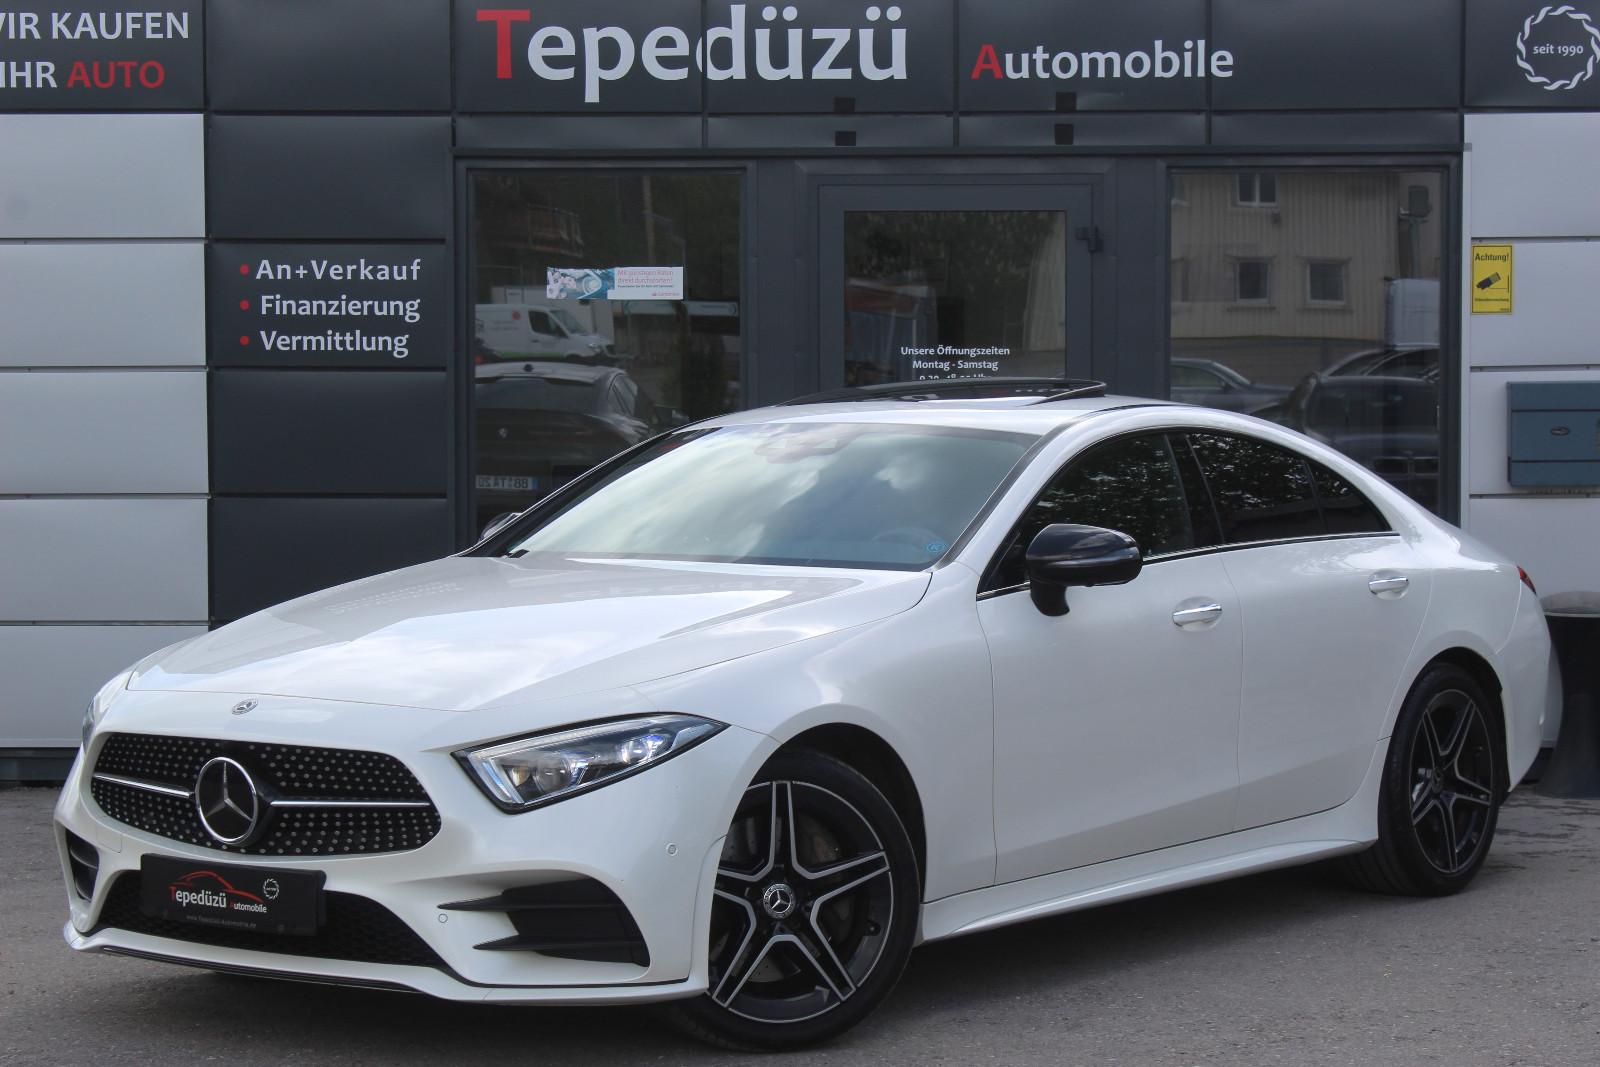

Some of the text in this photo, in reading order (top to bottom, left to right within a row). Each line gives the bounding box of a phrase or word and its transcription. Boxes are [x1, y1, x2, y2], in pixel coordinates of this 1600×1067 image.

[0, 12, 190, 40] IR KAUFEN
[476, 4, 908, 103] Tepedüzü
[971, 39, 1234, 80] Automobile
[1533, 44, 1584, 57] seit 1990
[0, 60, 166, 89] IHR AUTO
[255, 258, 421, 281] An+Verkauf
[1475, 253, 1510, 263] Achtung!
[261, 294, 421, 323] Finanzierung
[259, 329, 409, 359] Vermittlung
[900, 344, 1010, 358] Unsere Öffnungszeiten
[912, 360, 950, 372] Montag
[957, 360, 999, 372] Samstag
[169, 886, 268, 913] Tepedüzü Automobile
